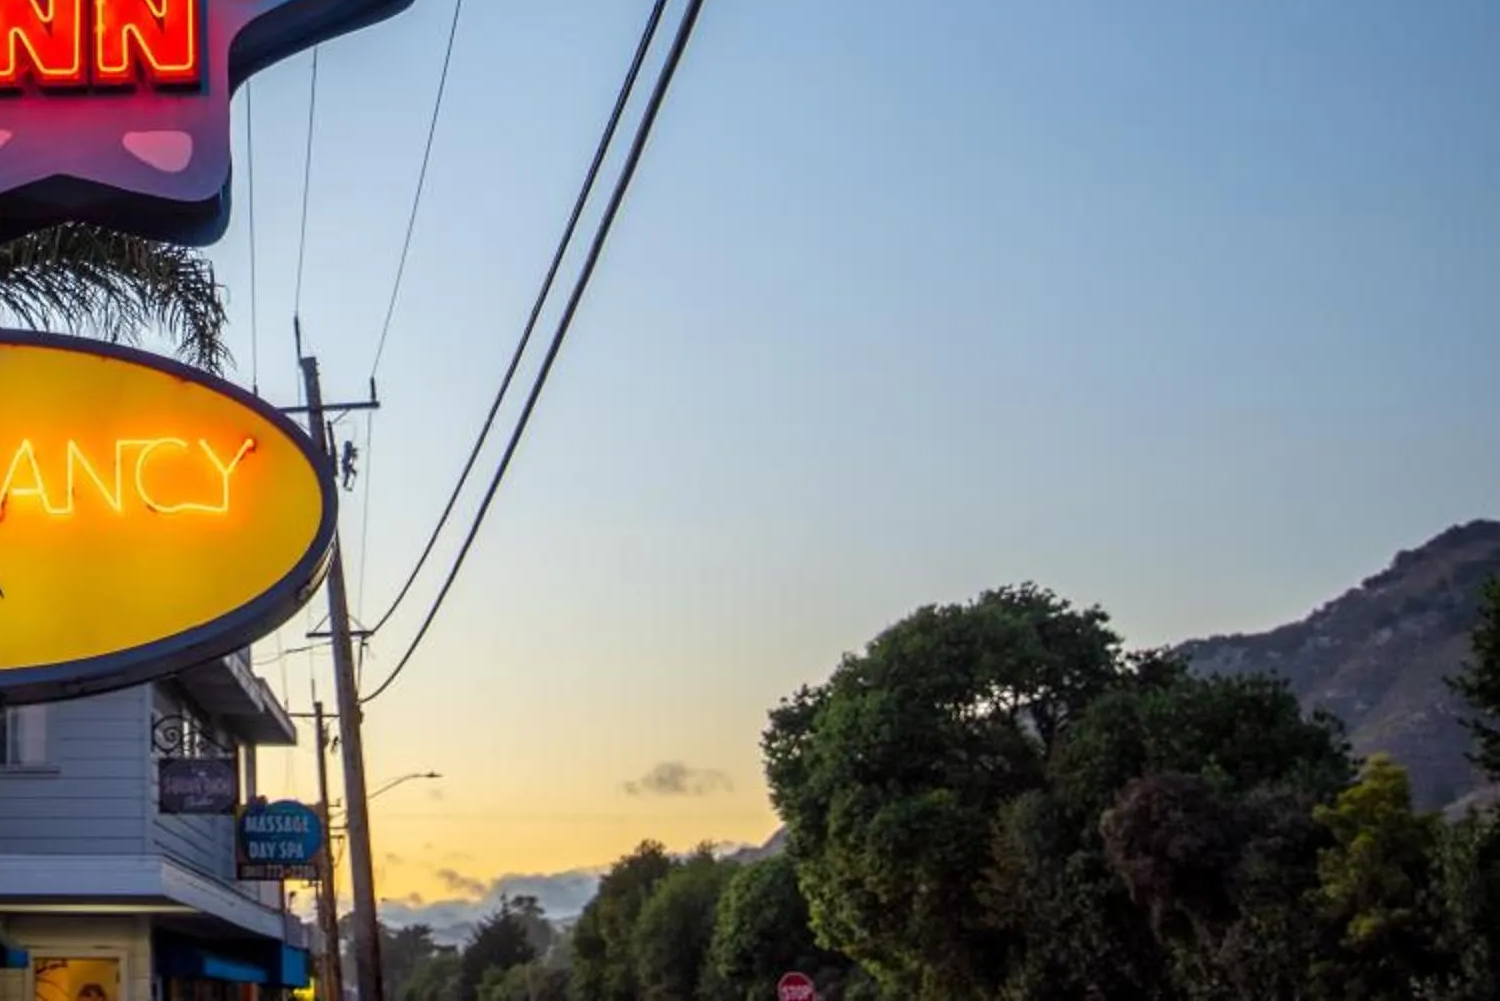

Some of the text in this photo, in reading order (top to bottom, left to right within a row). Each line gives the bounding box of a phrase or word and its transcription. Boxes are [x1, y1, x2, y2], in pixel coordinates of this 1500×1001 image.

[244, 814, 310, 833] MASSAGE
[249, 841, 304, 860] DAY SPA
